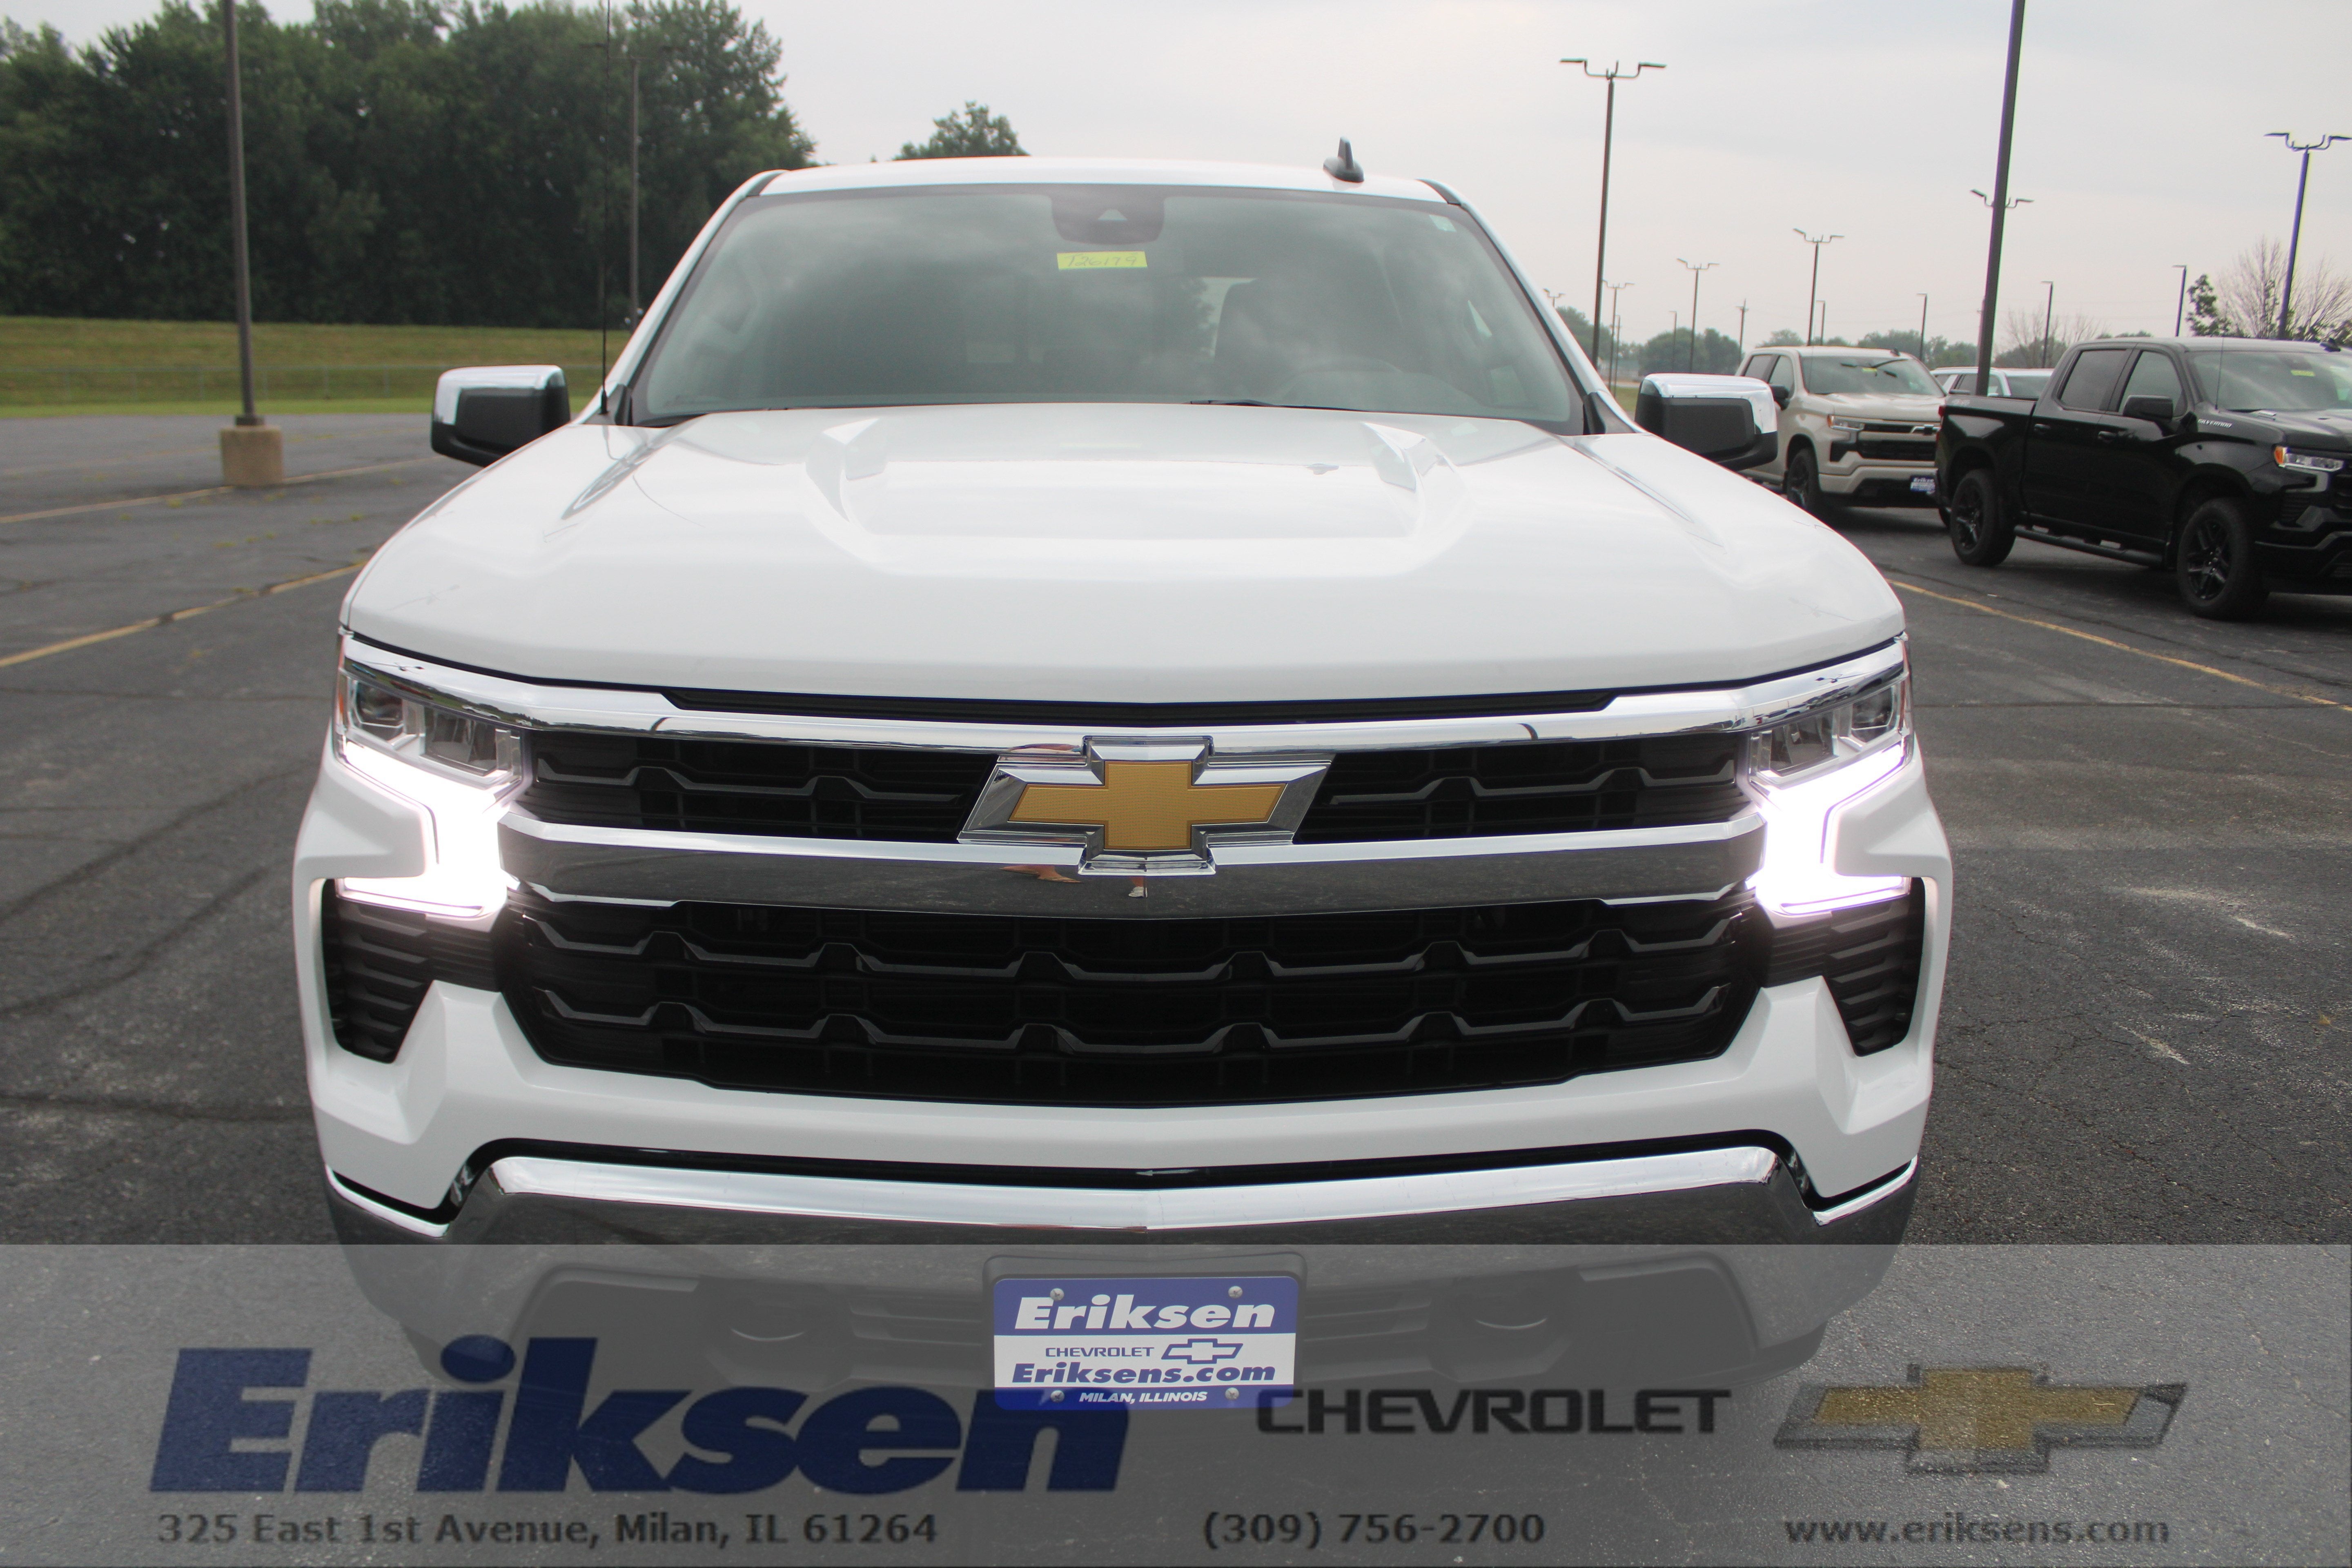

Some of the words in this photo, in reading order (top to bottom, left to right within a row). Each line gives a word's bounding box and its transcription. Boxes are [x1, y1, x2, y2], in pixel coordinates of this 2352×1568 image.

[1015, 1294, 1275, 1330] Eriksen
[1045, 1347, 1154, 1357] CHEVROLET
[1012, 1362, 1276, 1384] Eriksens.com
[1079, 1391, 1136, 1404] MILAN,
[1139, 1391, 1208, 1402] ILLINOIS
